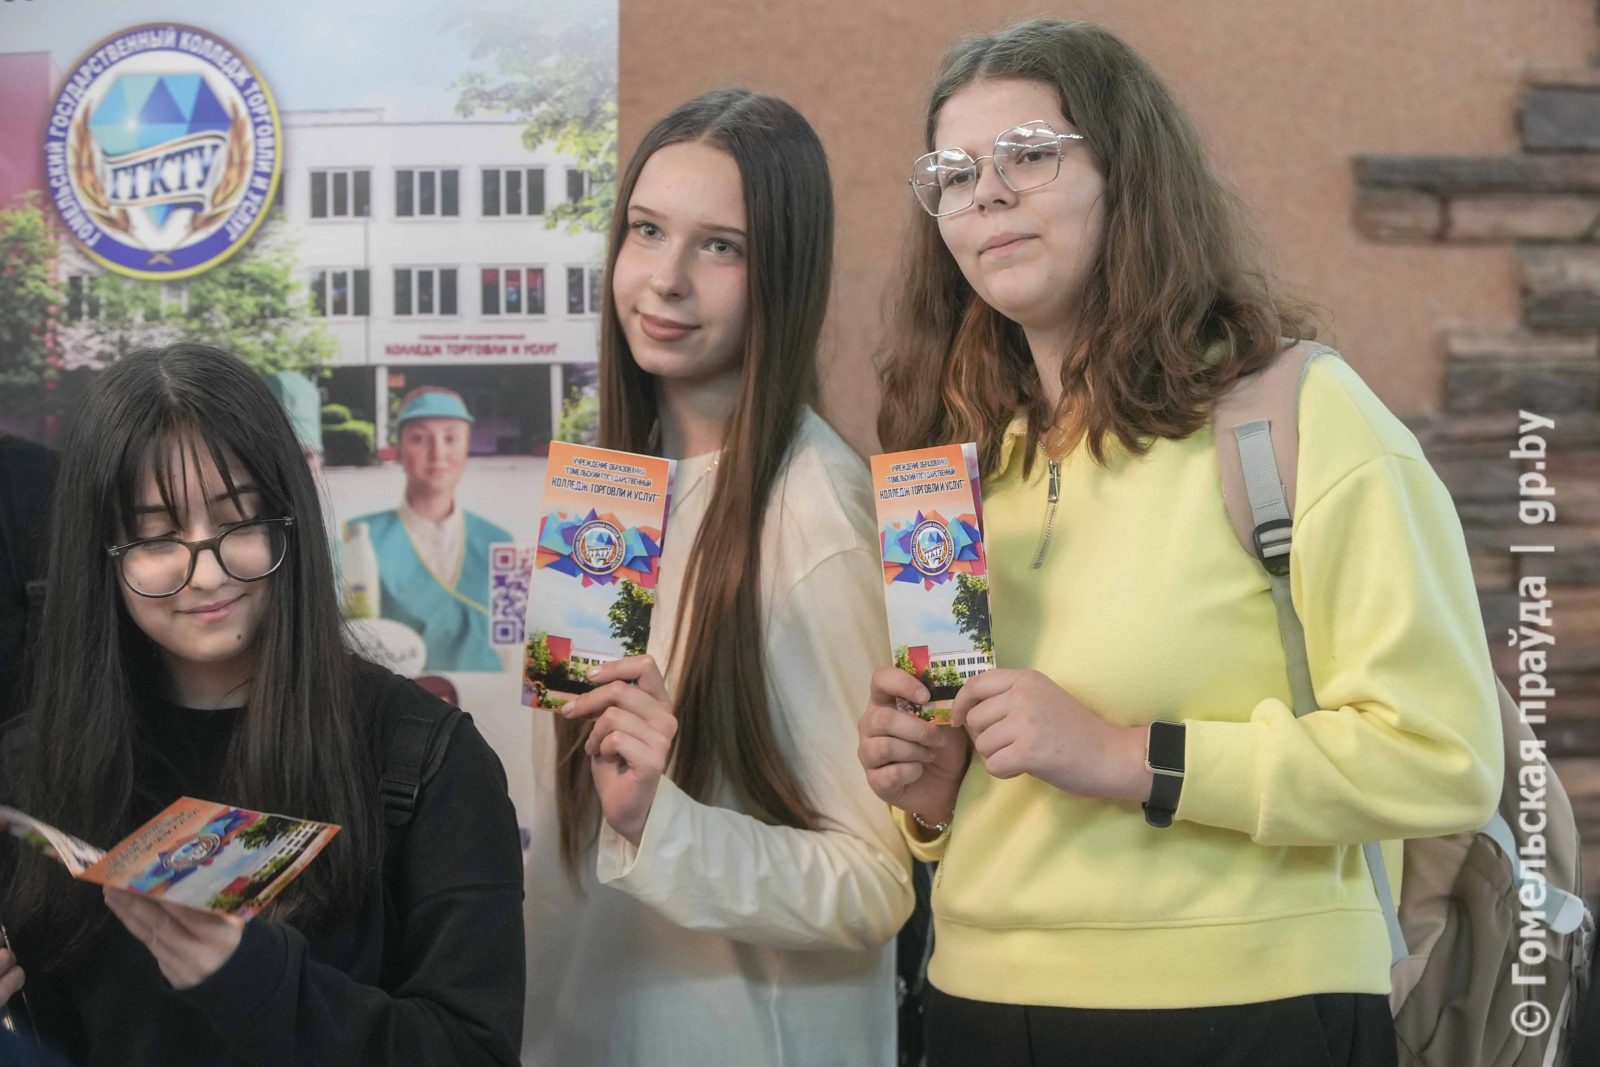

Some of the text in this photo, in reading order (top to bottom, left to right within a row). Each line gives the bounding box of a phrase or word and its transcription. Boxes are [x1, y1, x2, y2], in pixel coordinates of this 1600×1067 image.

[45, 28, 275, 246] ГОМЕЛЬСКИЙ ГОСУДАРСТВЕННЫЙ КОЛЛЕДЖ ТОРГОВЛИ И УСЛУГ
[385, 344, 441, 356] КОЛЛЕДЖ
[447, 344, 507, 356] ТОРГОВЛИ
[524, 343, 558, 355] УСЛУГ
[551, 476, 588, 492] КОЛЛЕДЖ
[590, 483, 626, 498] ТОРГОВЛИ
[627, 489, 633, 500] И
[880, 487, 910, 500] КОЛЛЕДЖ
[911, 482, 939, 496] ТОРГОВЛИ
